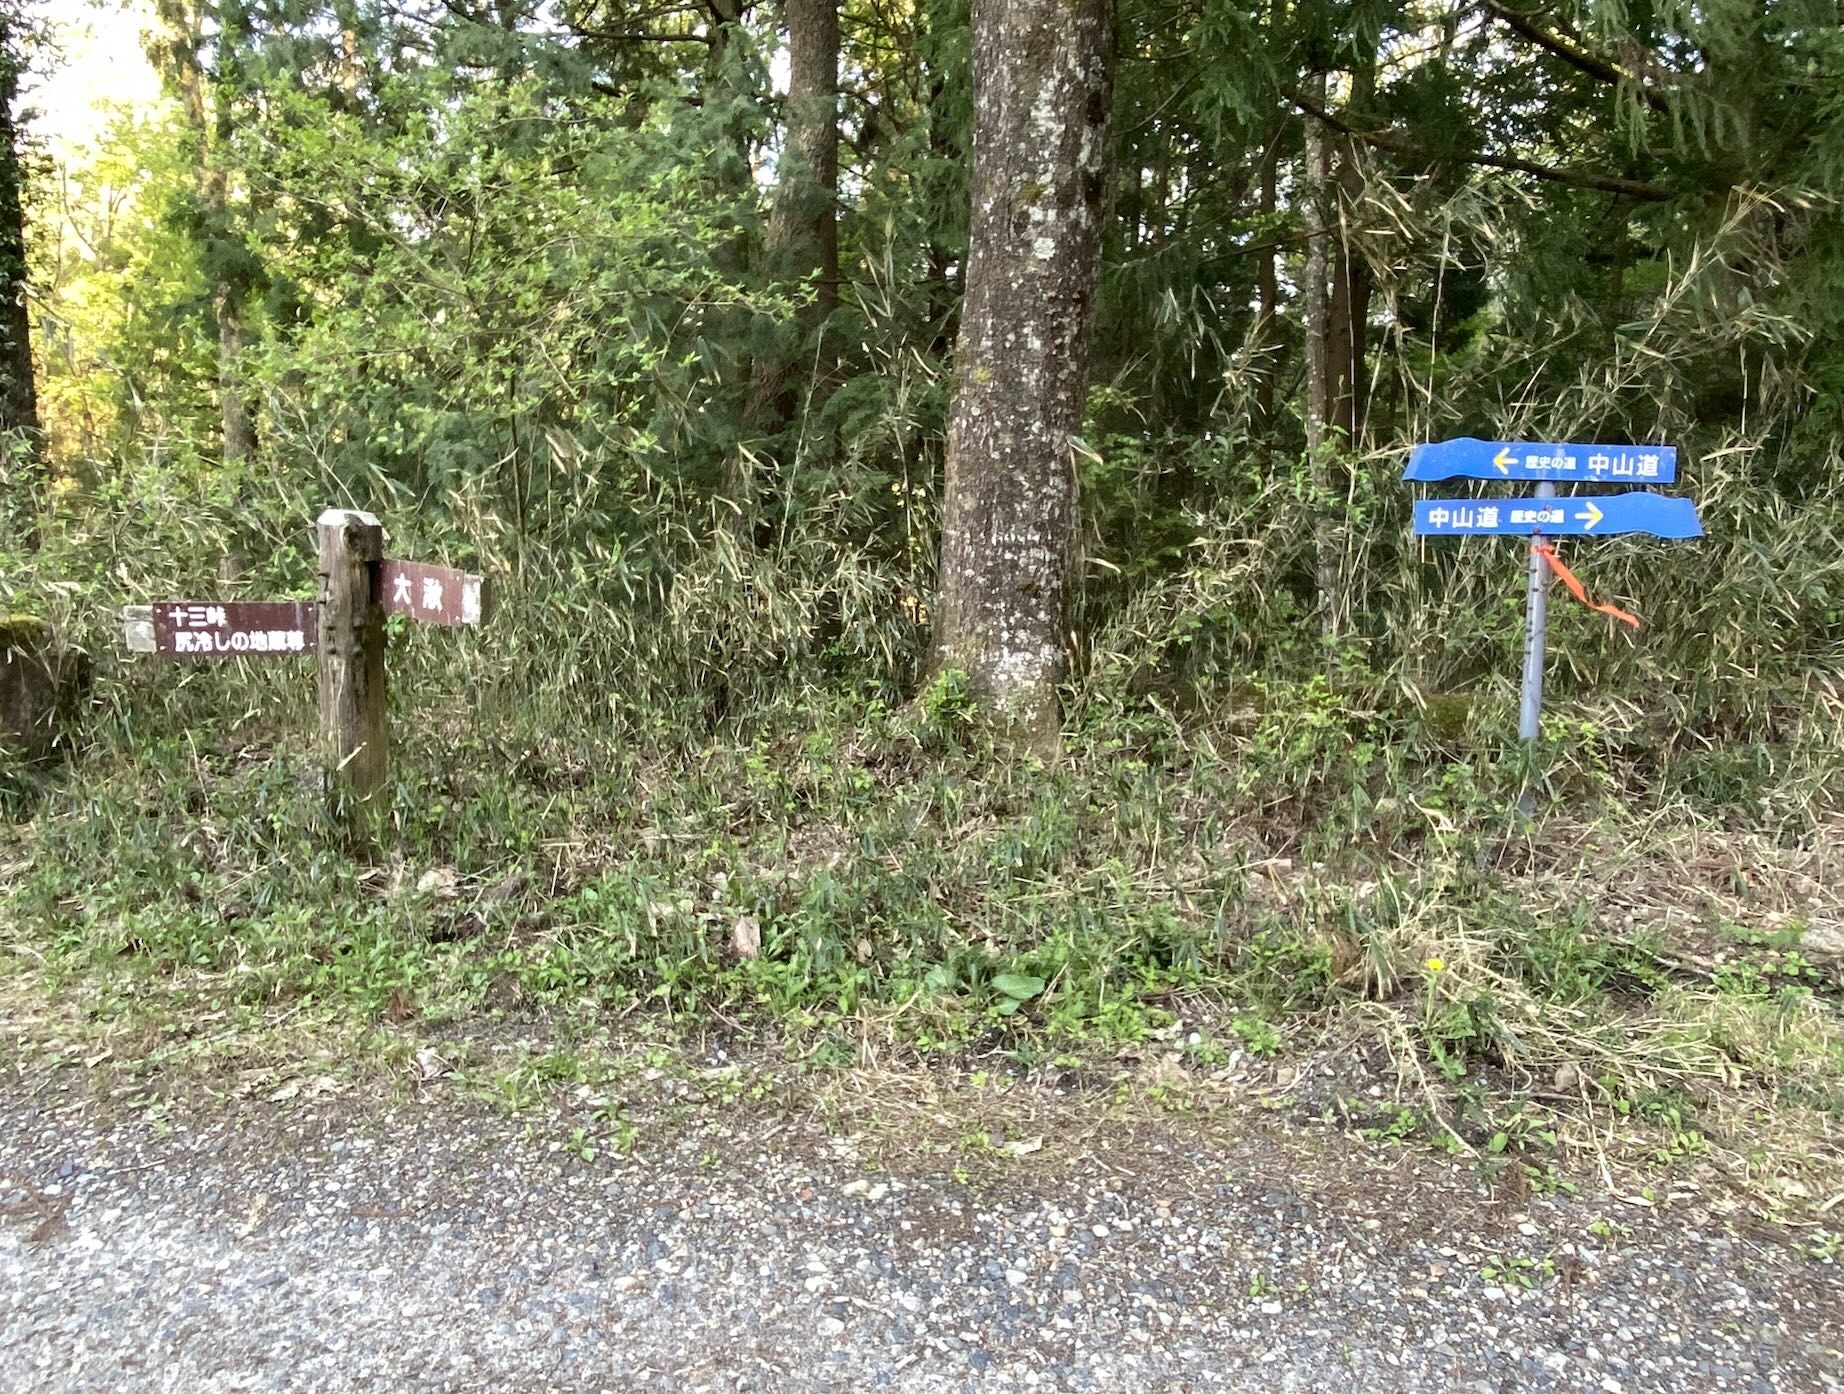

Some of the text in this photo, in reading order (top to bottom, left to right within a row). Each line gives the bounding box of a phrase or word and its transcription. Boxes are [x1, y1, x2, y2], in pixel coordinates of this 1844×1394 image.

[1588, 453, 1659, 477] 中山道
[1428, 506, 1498, 528] 中山道
